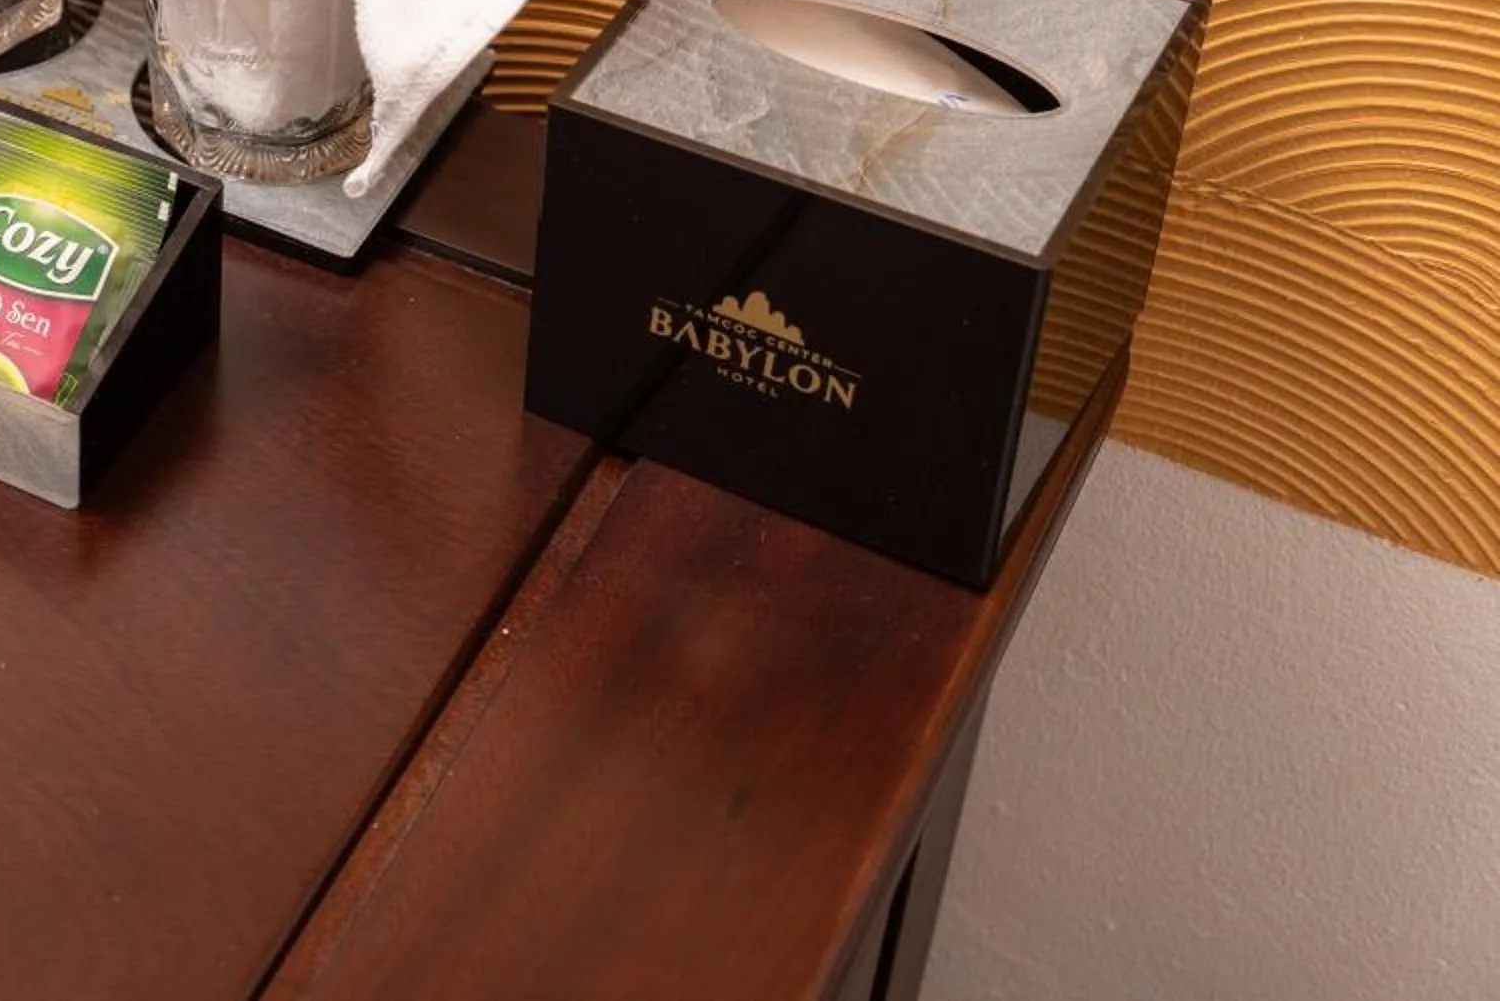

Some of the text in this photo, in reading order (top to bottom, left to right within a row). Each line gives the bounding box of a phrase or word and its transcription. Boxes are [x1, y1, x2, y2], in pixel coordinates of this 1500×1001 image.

[5, 299, 51, 337] Sen
[650, 306, 857, 409] BABYLON
[764, 336, 834, 369] CENTER
[716, 365, 780, 399] HOTEL
